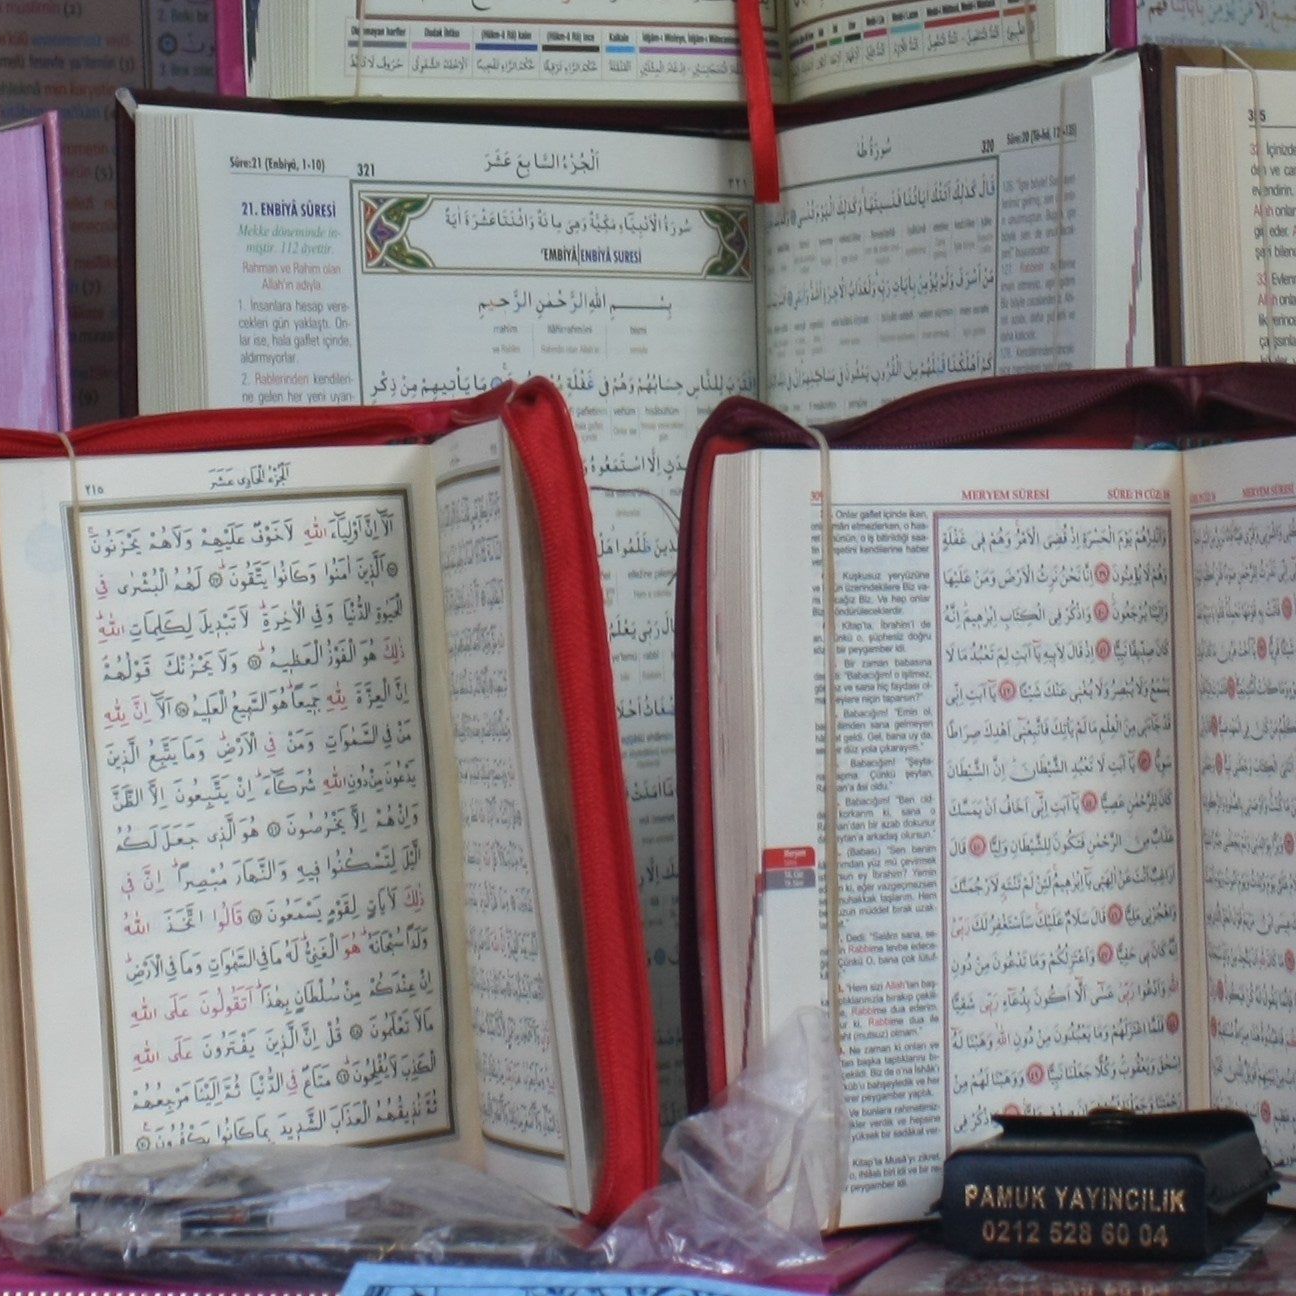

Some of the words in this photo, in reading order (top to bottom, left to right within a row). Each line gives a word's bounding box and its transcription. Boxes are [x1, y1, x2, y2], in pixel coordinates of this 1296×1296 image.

[358, 163, 374, 177] 321
[241, 202, 258, 216] 21.
[965, 1184, 1046, 1210] PAMUK
[1055, 1187, 1186, 1213] YAYINCILIK
[982, 1220, 1040, 1243] 0212
[1050, 1221, 1092, 1245] 528
[1101, 1222, 1130, 1247] 60
[1139, 1224, 1169, 1247] 04
